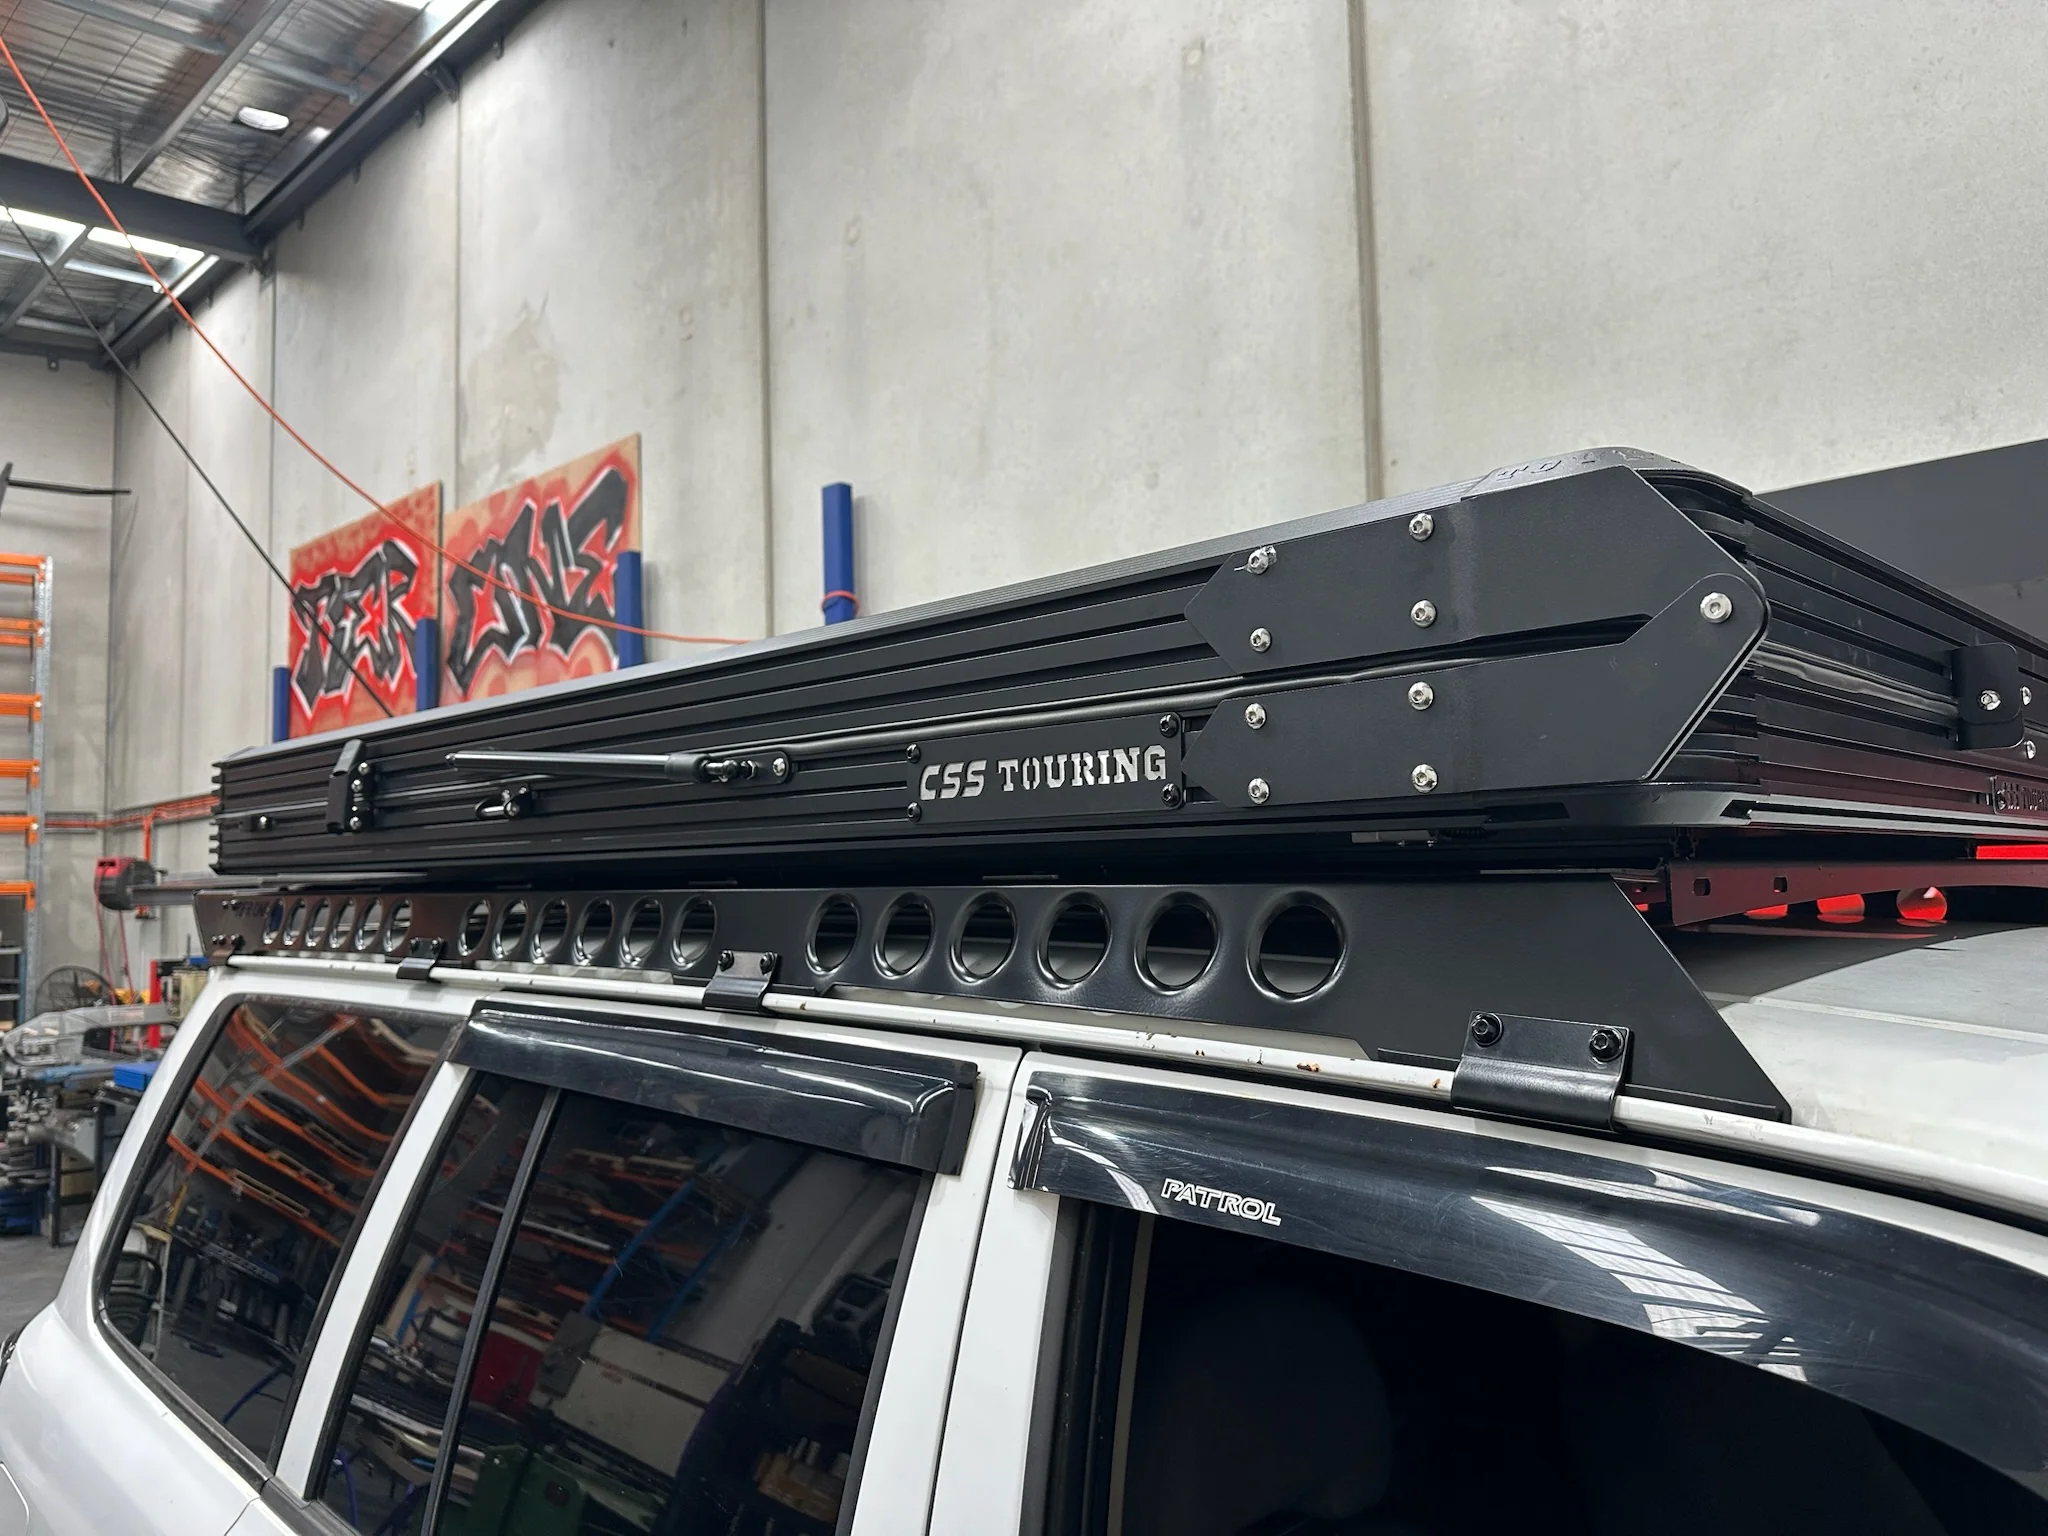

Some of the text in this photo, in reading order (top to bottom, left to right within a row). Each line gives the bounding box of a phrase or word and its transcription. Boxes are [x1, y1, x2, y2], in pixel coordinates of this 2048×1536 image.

[919, 744, 1167, 801] CSS TOURING
[1160, 1177, 1282, 1226] PATROL
